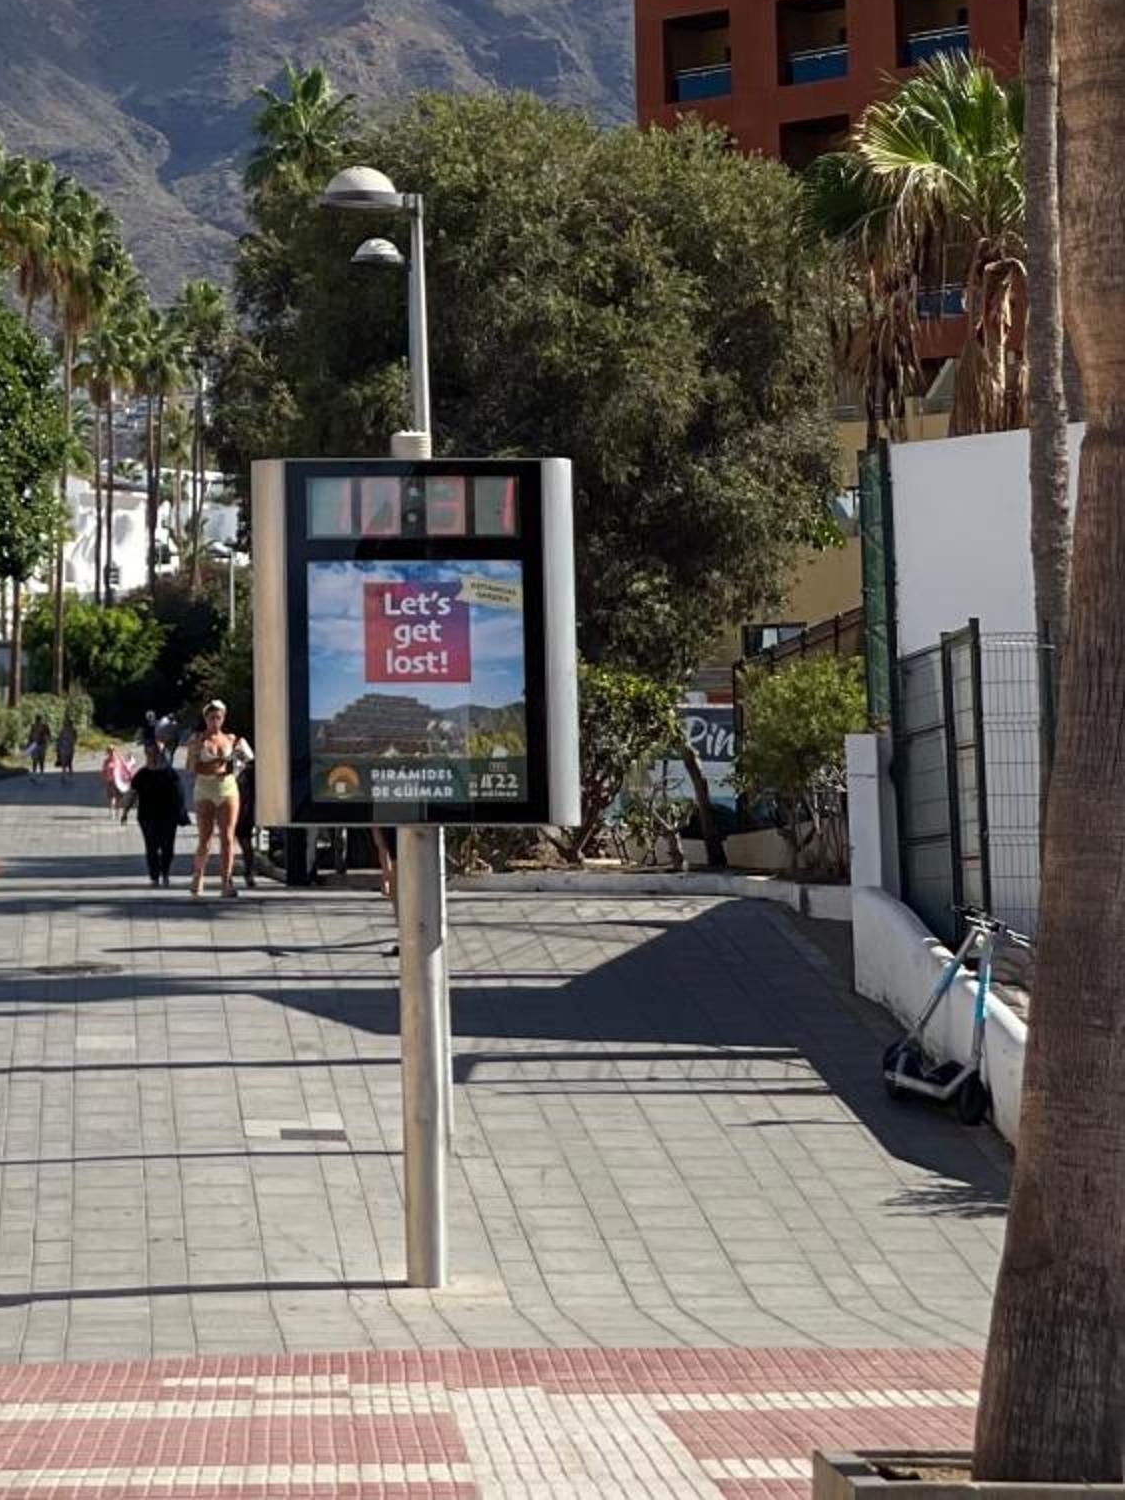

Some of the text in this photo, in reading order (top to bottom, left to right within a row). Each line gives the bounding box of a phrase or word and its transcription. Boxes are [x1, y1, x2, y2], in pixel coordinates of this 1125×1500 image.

[384, 591, 452, 616] Let's
[394, 619, 443, 650] get
[385, 648, 449, 675] lost!
[370, 785, 391, 799] DE
